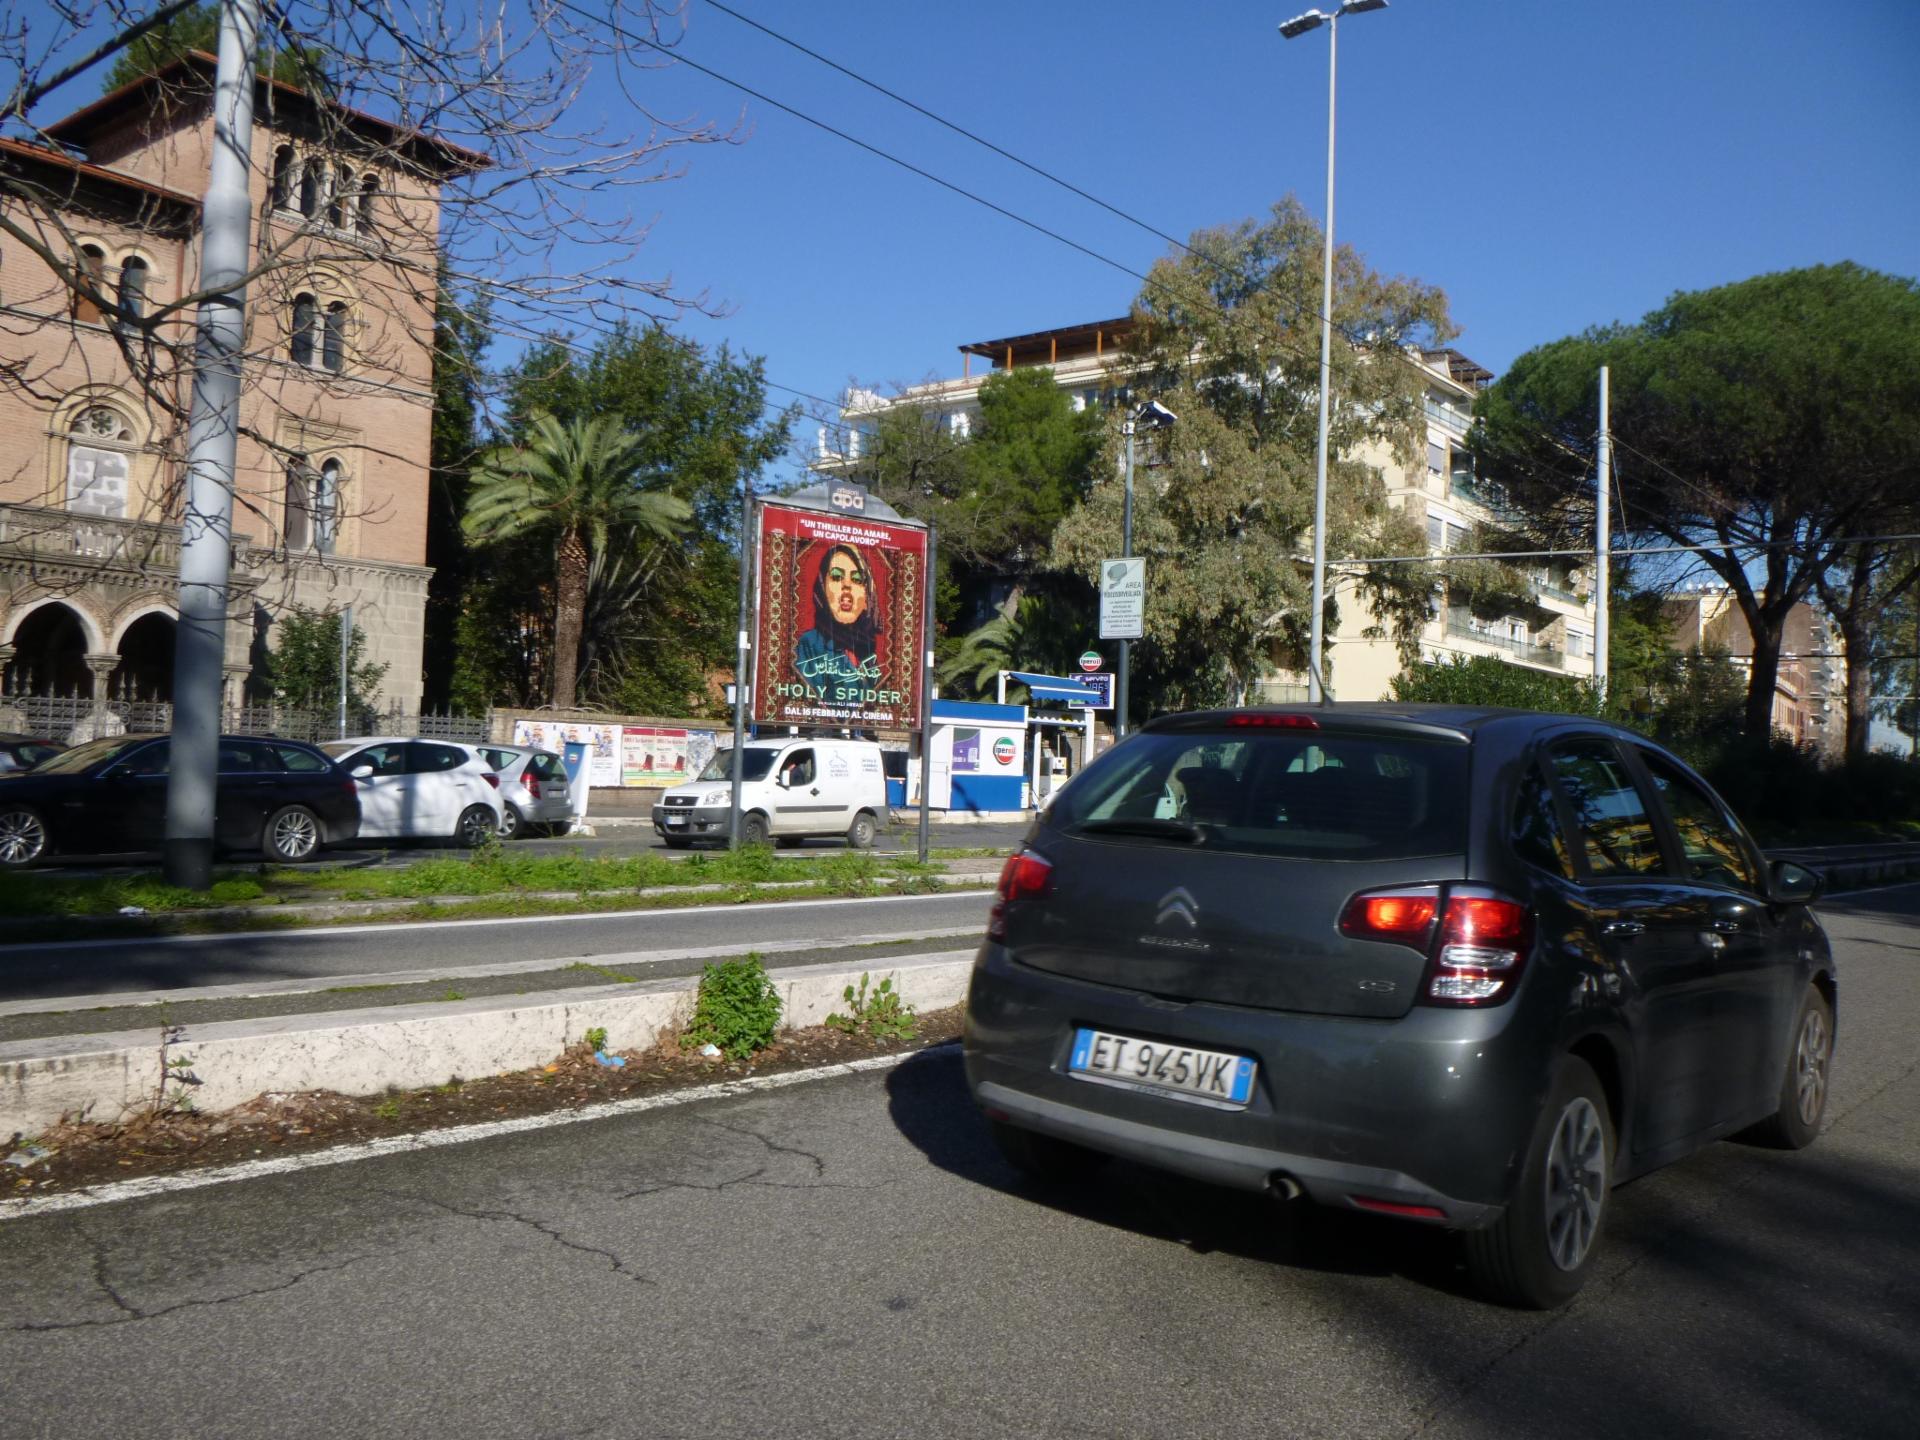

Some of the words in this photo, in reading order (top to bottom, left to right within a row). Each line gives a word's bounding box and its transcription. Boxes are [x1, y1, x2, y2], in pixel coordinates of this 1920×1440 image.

[832, 492, 864, 510] apa
[813, 530, 824, 538] UN
[817, 522, 851, 534] THRILLER
[852, 527, 863, 535] DA
[864, 529, 891, 541] AMARE,
[777, 683, 827, 699] HOLY
[835, 687, 901, 703] SPIDER
[785, 706, 801, 715] DAL
[802, 707, 811, 716] 16
[812, 708, 850, 718] FEBBRAIO
[851, 710, 862, 719] AL
[863, 711, 894, 721] CINEMA
